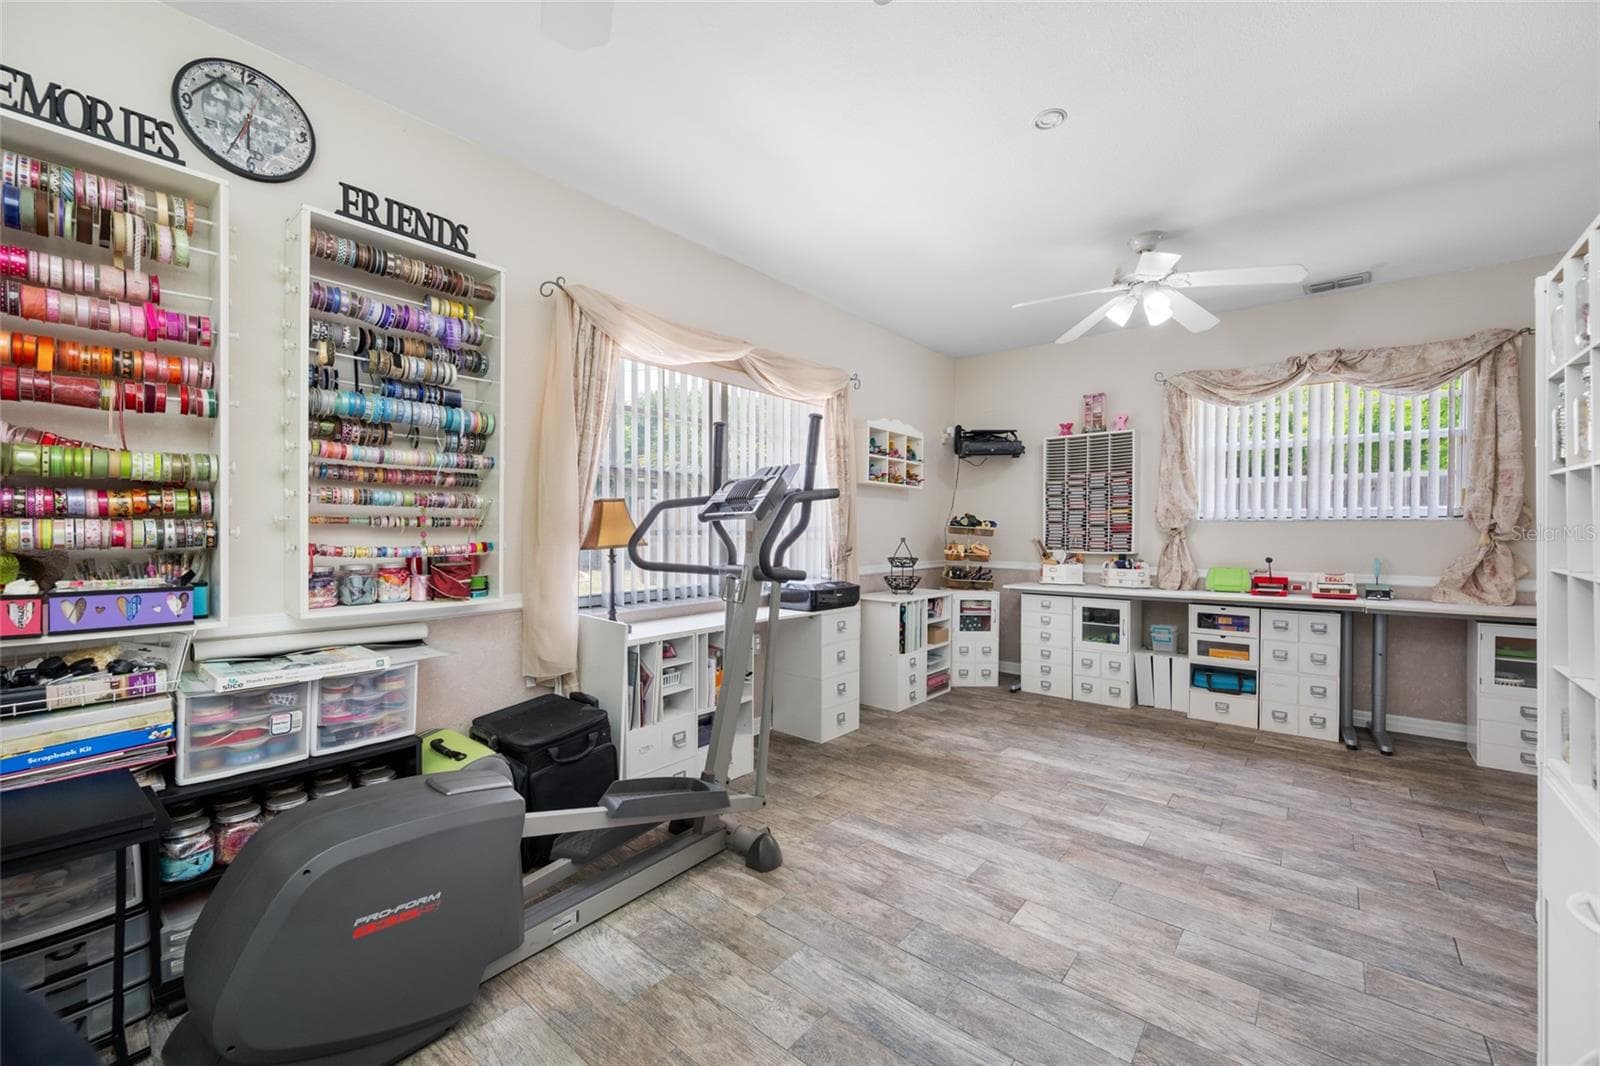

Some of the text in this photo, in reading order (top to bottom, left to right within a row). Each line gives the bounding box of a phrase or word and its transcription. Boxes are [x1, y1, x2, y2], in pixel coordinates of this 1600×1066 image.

[240, 68, 259, 88] 12
[181, 92, 193, 110] 9
[338, 181, 471, 254] FRIENDS
[222, 682, 244, 691] slice
[27, 745, 92, 765] Scrapbook Kit
[353, 891, 442, 927] PRO-FORM
